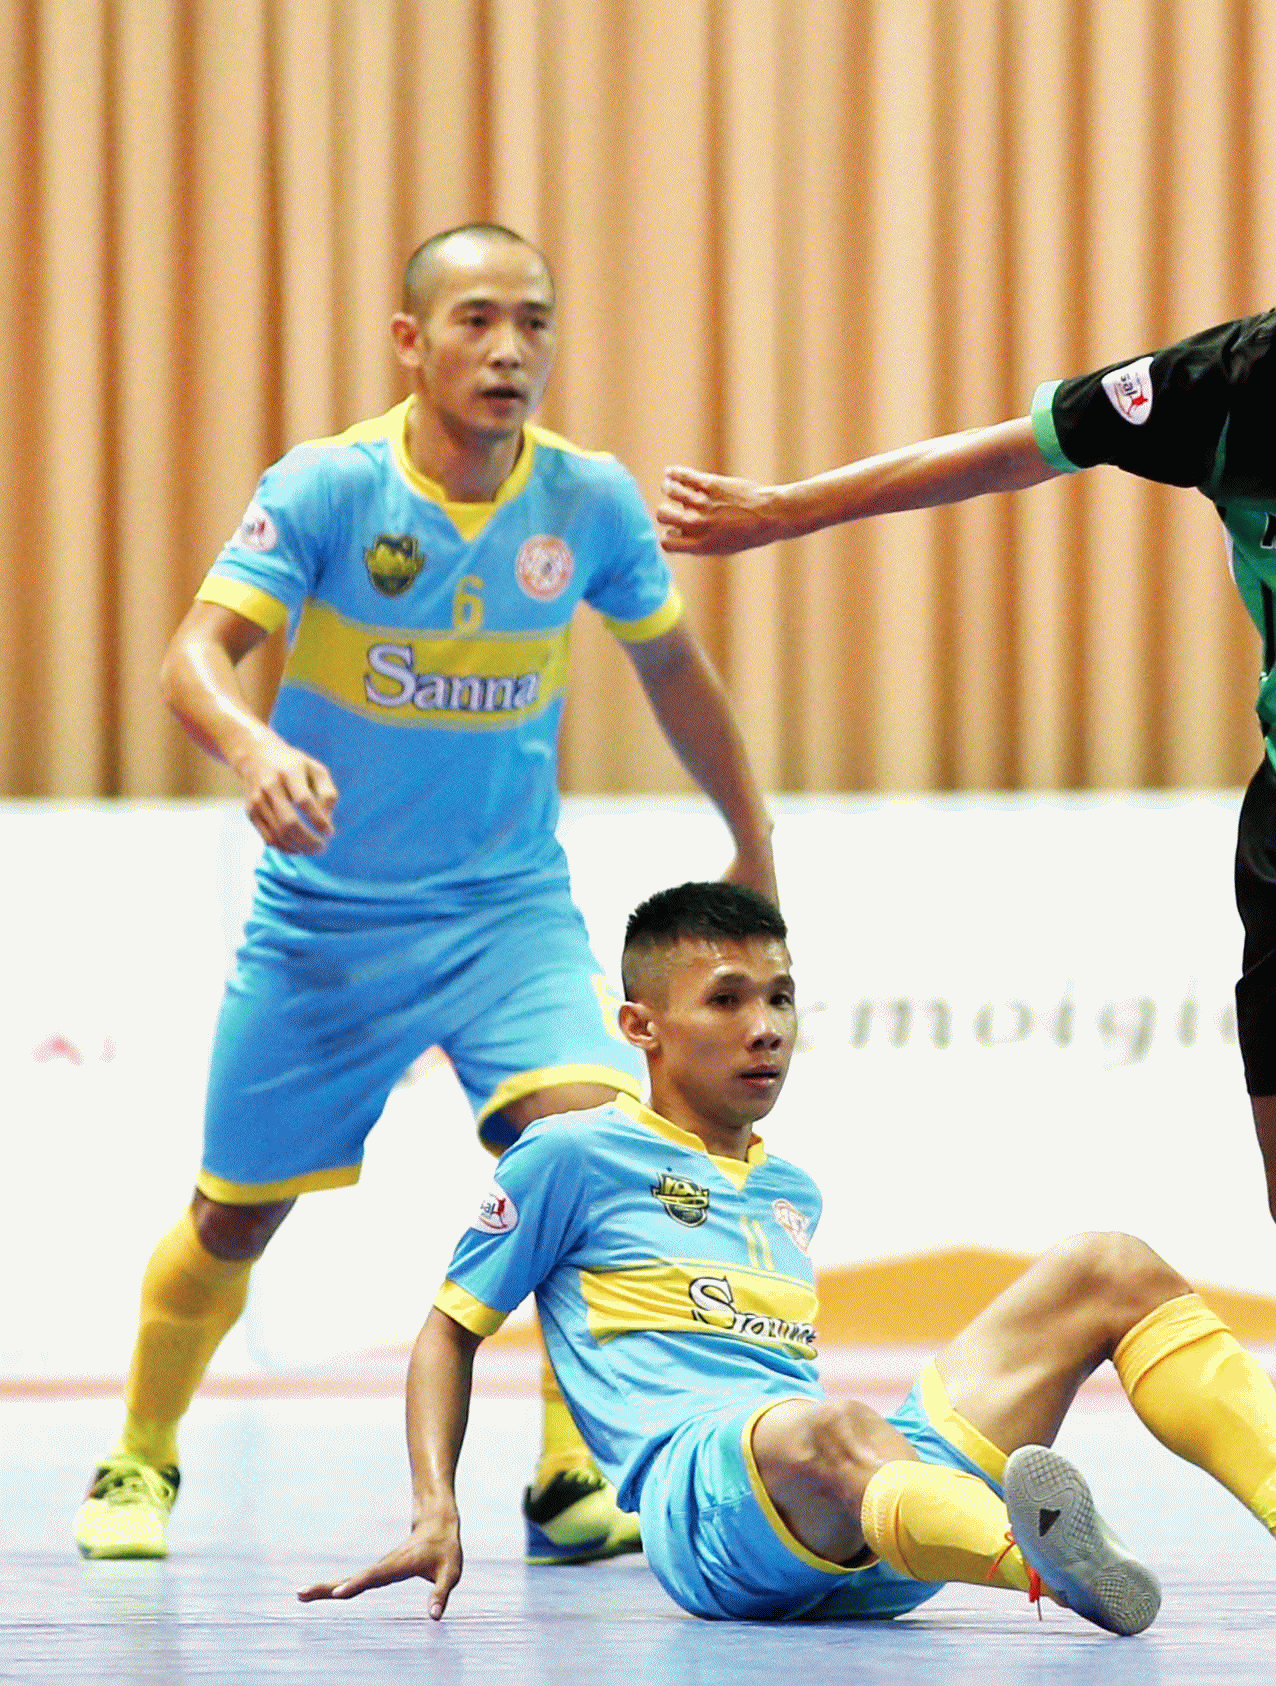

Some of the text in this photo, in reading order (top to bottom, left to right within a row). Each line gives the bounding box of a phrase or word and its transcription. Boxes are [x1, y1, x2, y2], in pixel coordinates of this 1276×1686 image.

[451, 575, 485, 633] 6
[364, 643, 541, 713] Sanna
[739, 1215, 775, 1272] 11
